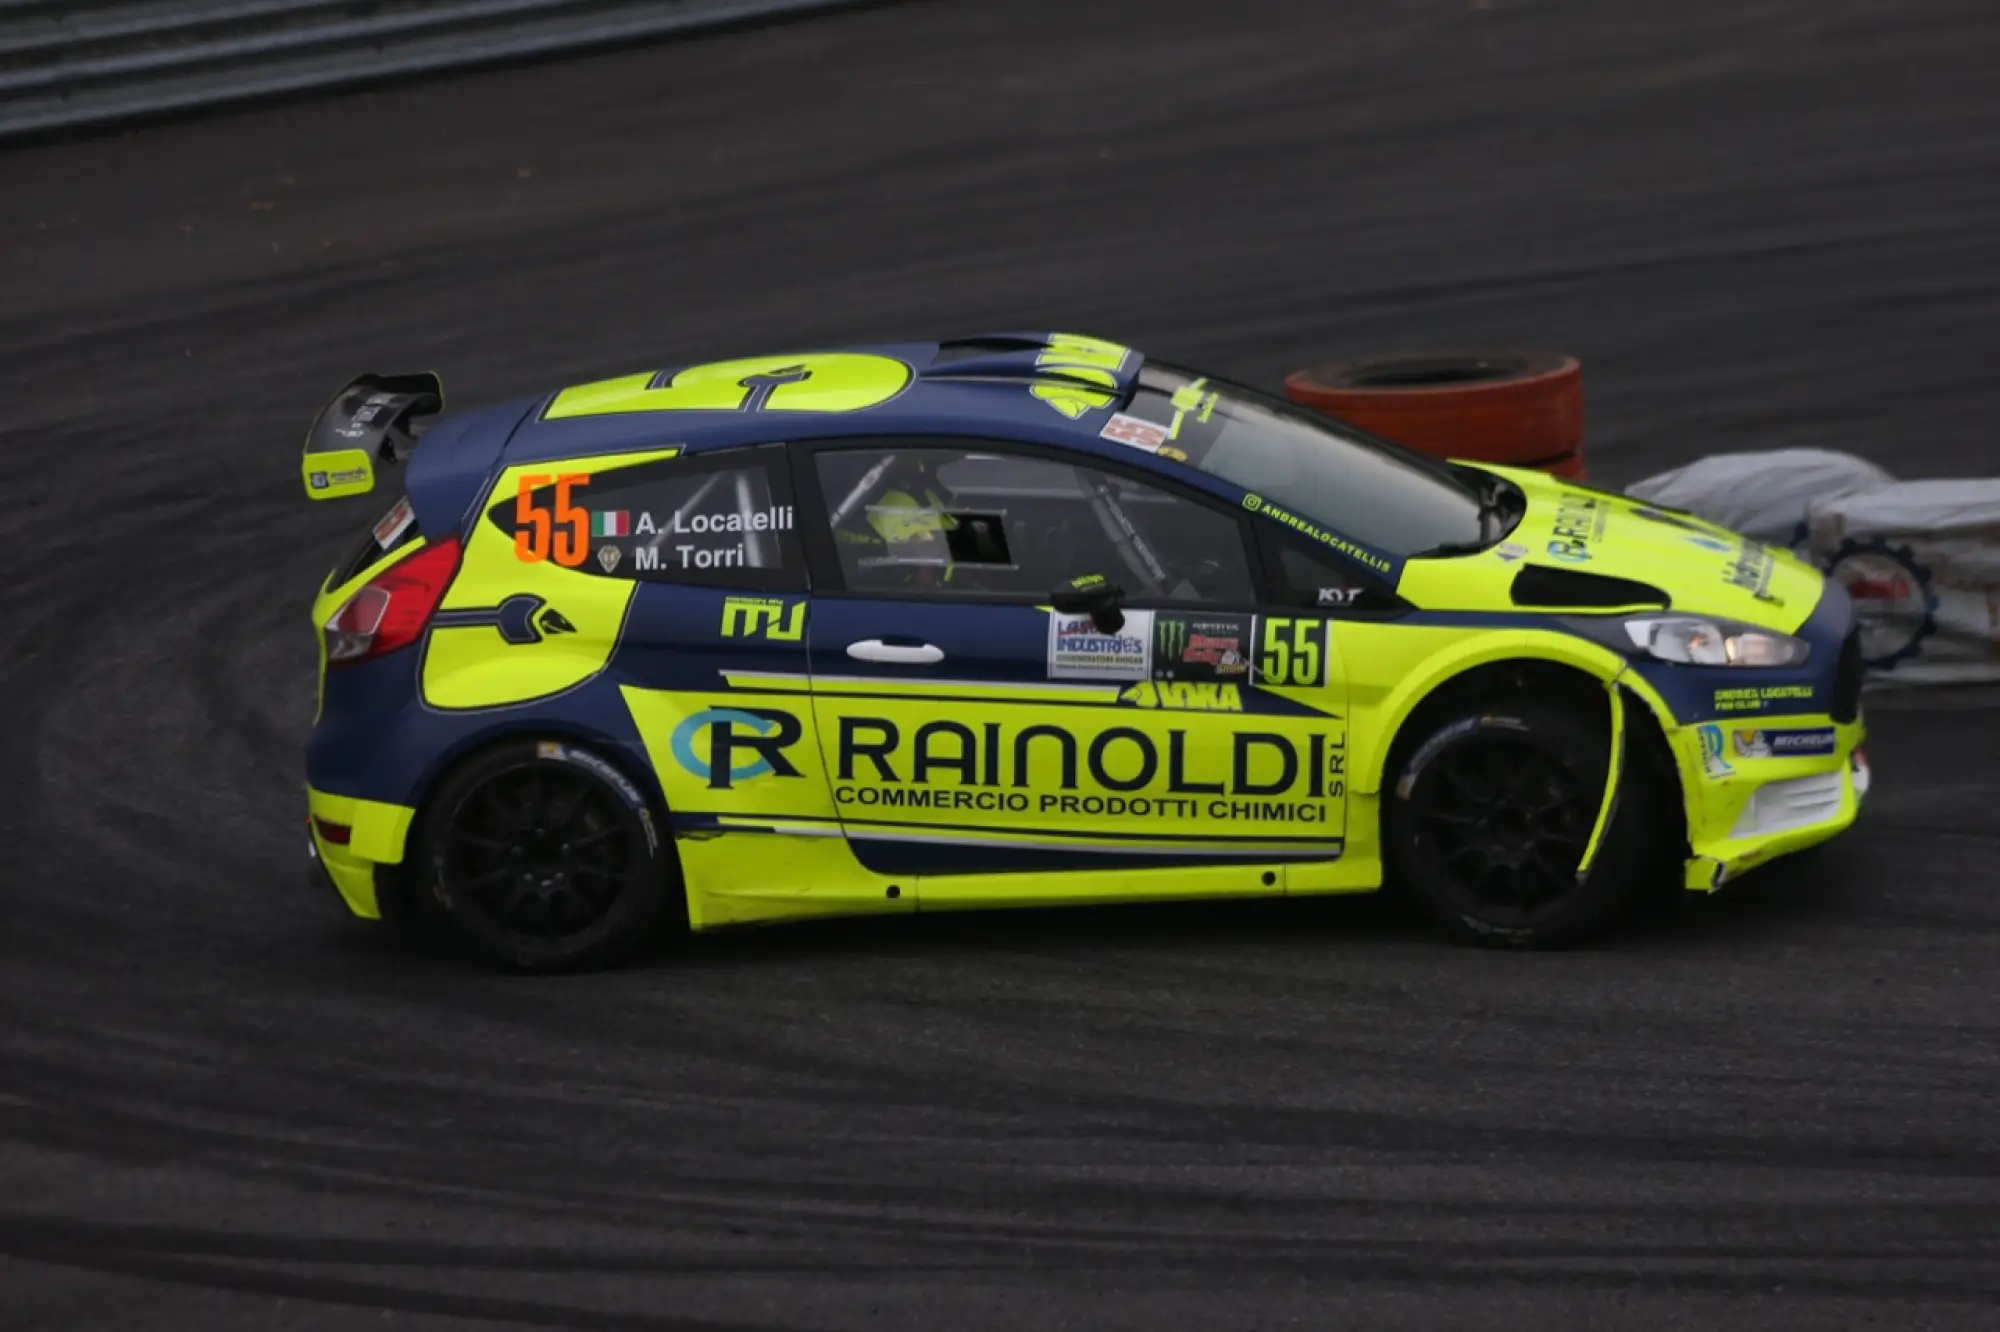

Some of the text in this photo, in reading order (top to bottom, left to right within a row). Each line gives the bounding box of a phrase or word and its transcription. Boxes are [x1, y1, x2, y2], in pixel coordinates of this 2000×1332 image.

[514, 474, 590, 567] 55
[635, 506, 794, 535] A. Locatelli
[635, 543, 744, 571] M. Torri
[1263, 617, 1321, 685] 55
[837, 715, 1326, 798] RAINOLDI
[1329, 731, 1346, 797] SRL
[834, 785, 1327, 822] COMMERCIO PRODOTTI CHIMICI
